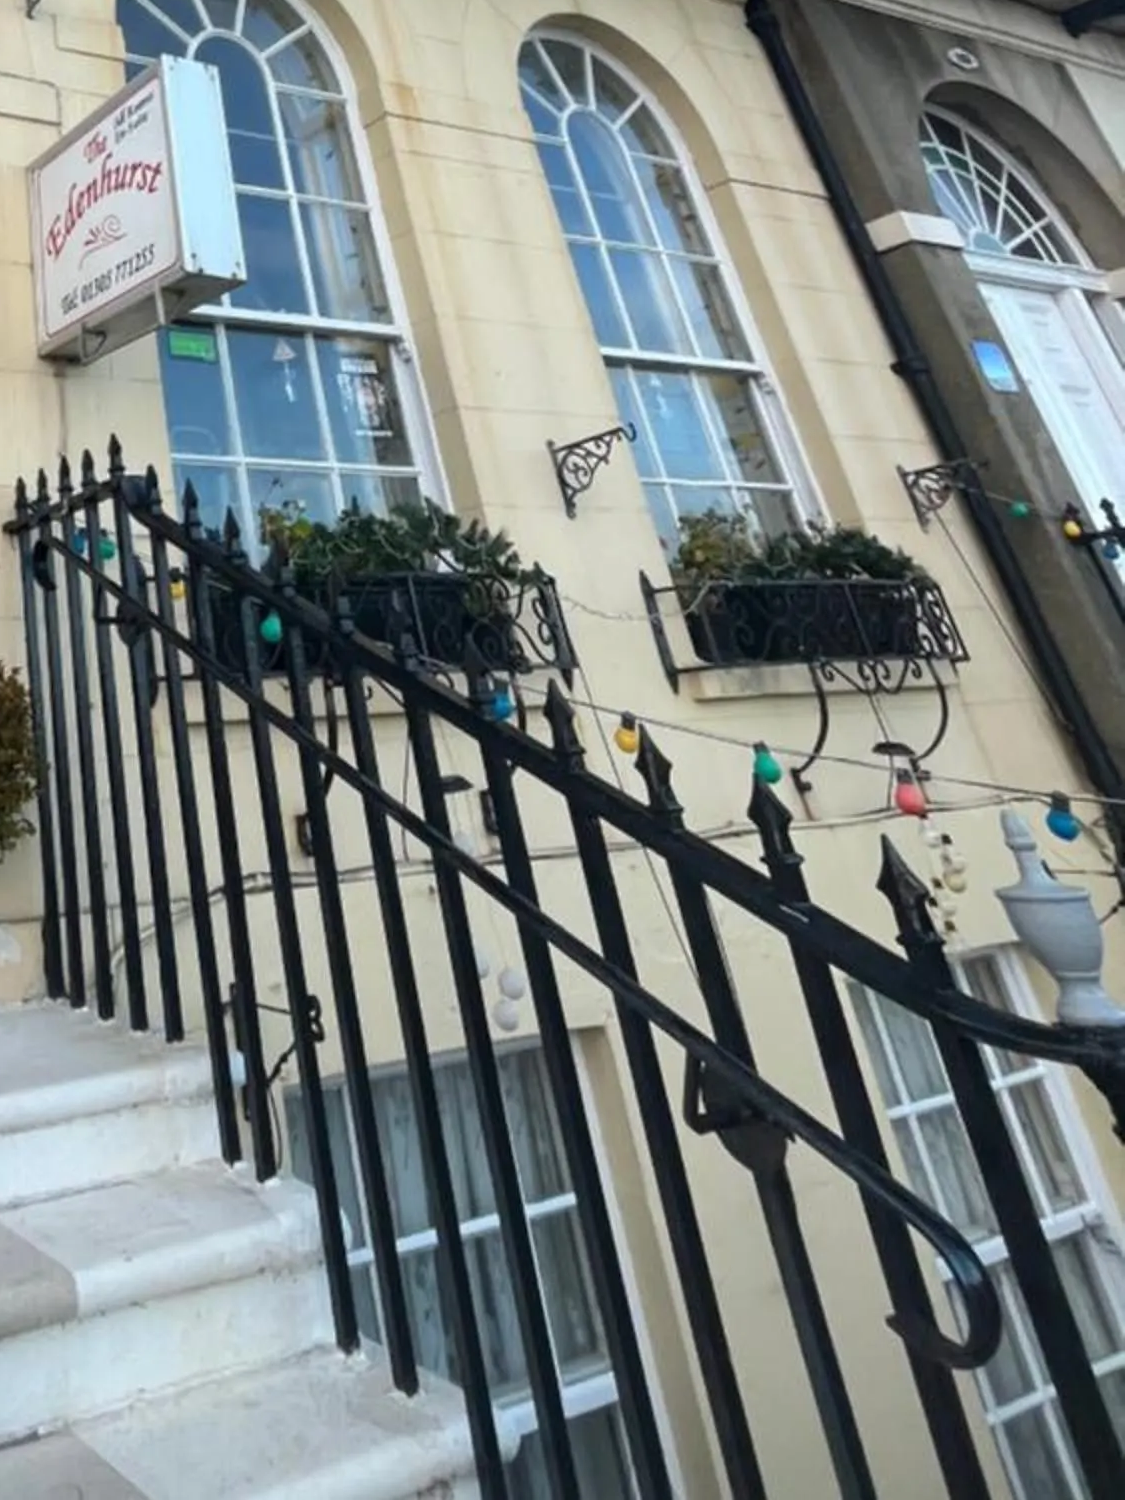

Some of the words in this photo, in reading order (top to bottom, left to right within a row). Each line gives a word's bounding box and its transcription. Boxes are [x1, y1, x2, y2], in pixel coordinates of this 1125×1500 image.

[83, 131, 108, 164] The
[47, 152, 162, 261] Edenhurst
[81, 269, 113, 303] 01305
[114, 243, 155, 284] 771255
